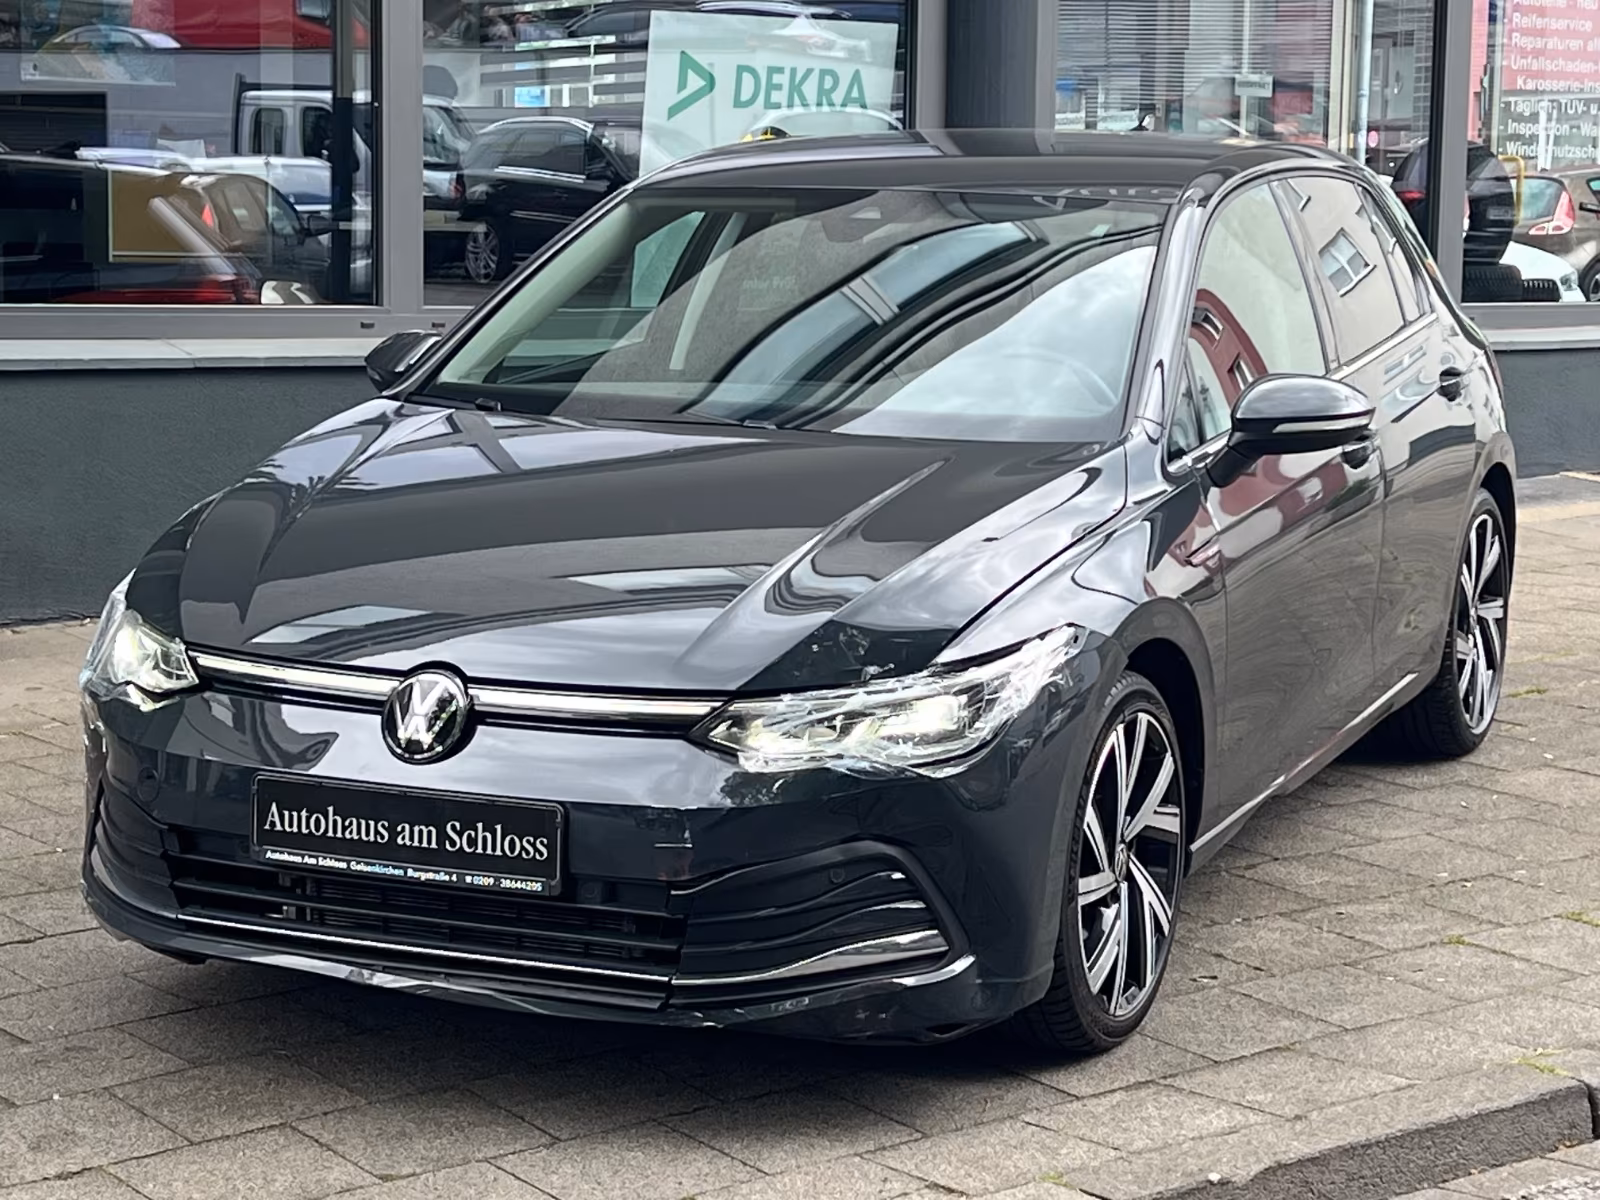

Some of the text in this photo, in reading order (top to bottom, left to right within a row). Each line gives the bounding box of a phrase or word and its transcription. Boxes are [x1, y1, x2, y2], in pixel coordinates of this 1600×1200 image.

[1512, 12, 1593, 32] Reifenservice
[1511, 32, 1584, 51] Reparaturen
[733, 64, 868, 109] DEKRA
[263, 801, 548, 860] Autohaus am Schloss
[265, 850, 302, 863] Autohaus
[303, 855, 317, 865] Am
[318, 856, 347, 869] Schloss
[350, 861, 404, 876] Gelsenkirchen
[451, 873, 458, 882] 4
